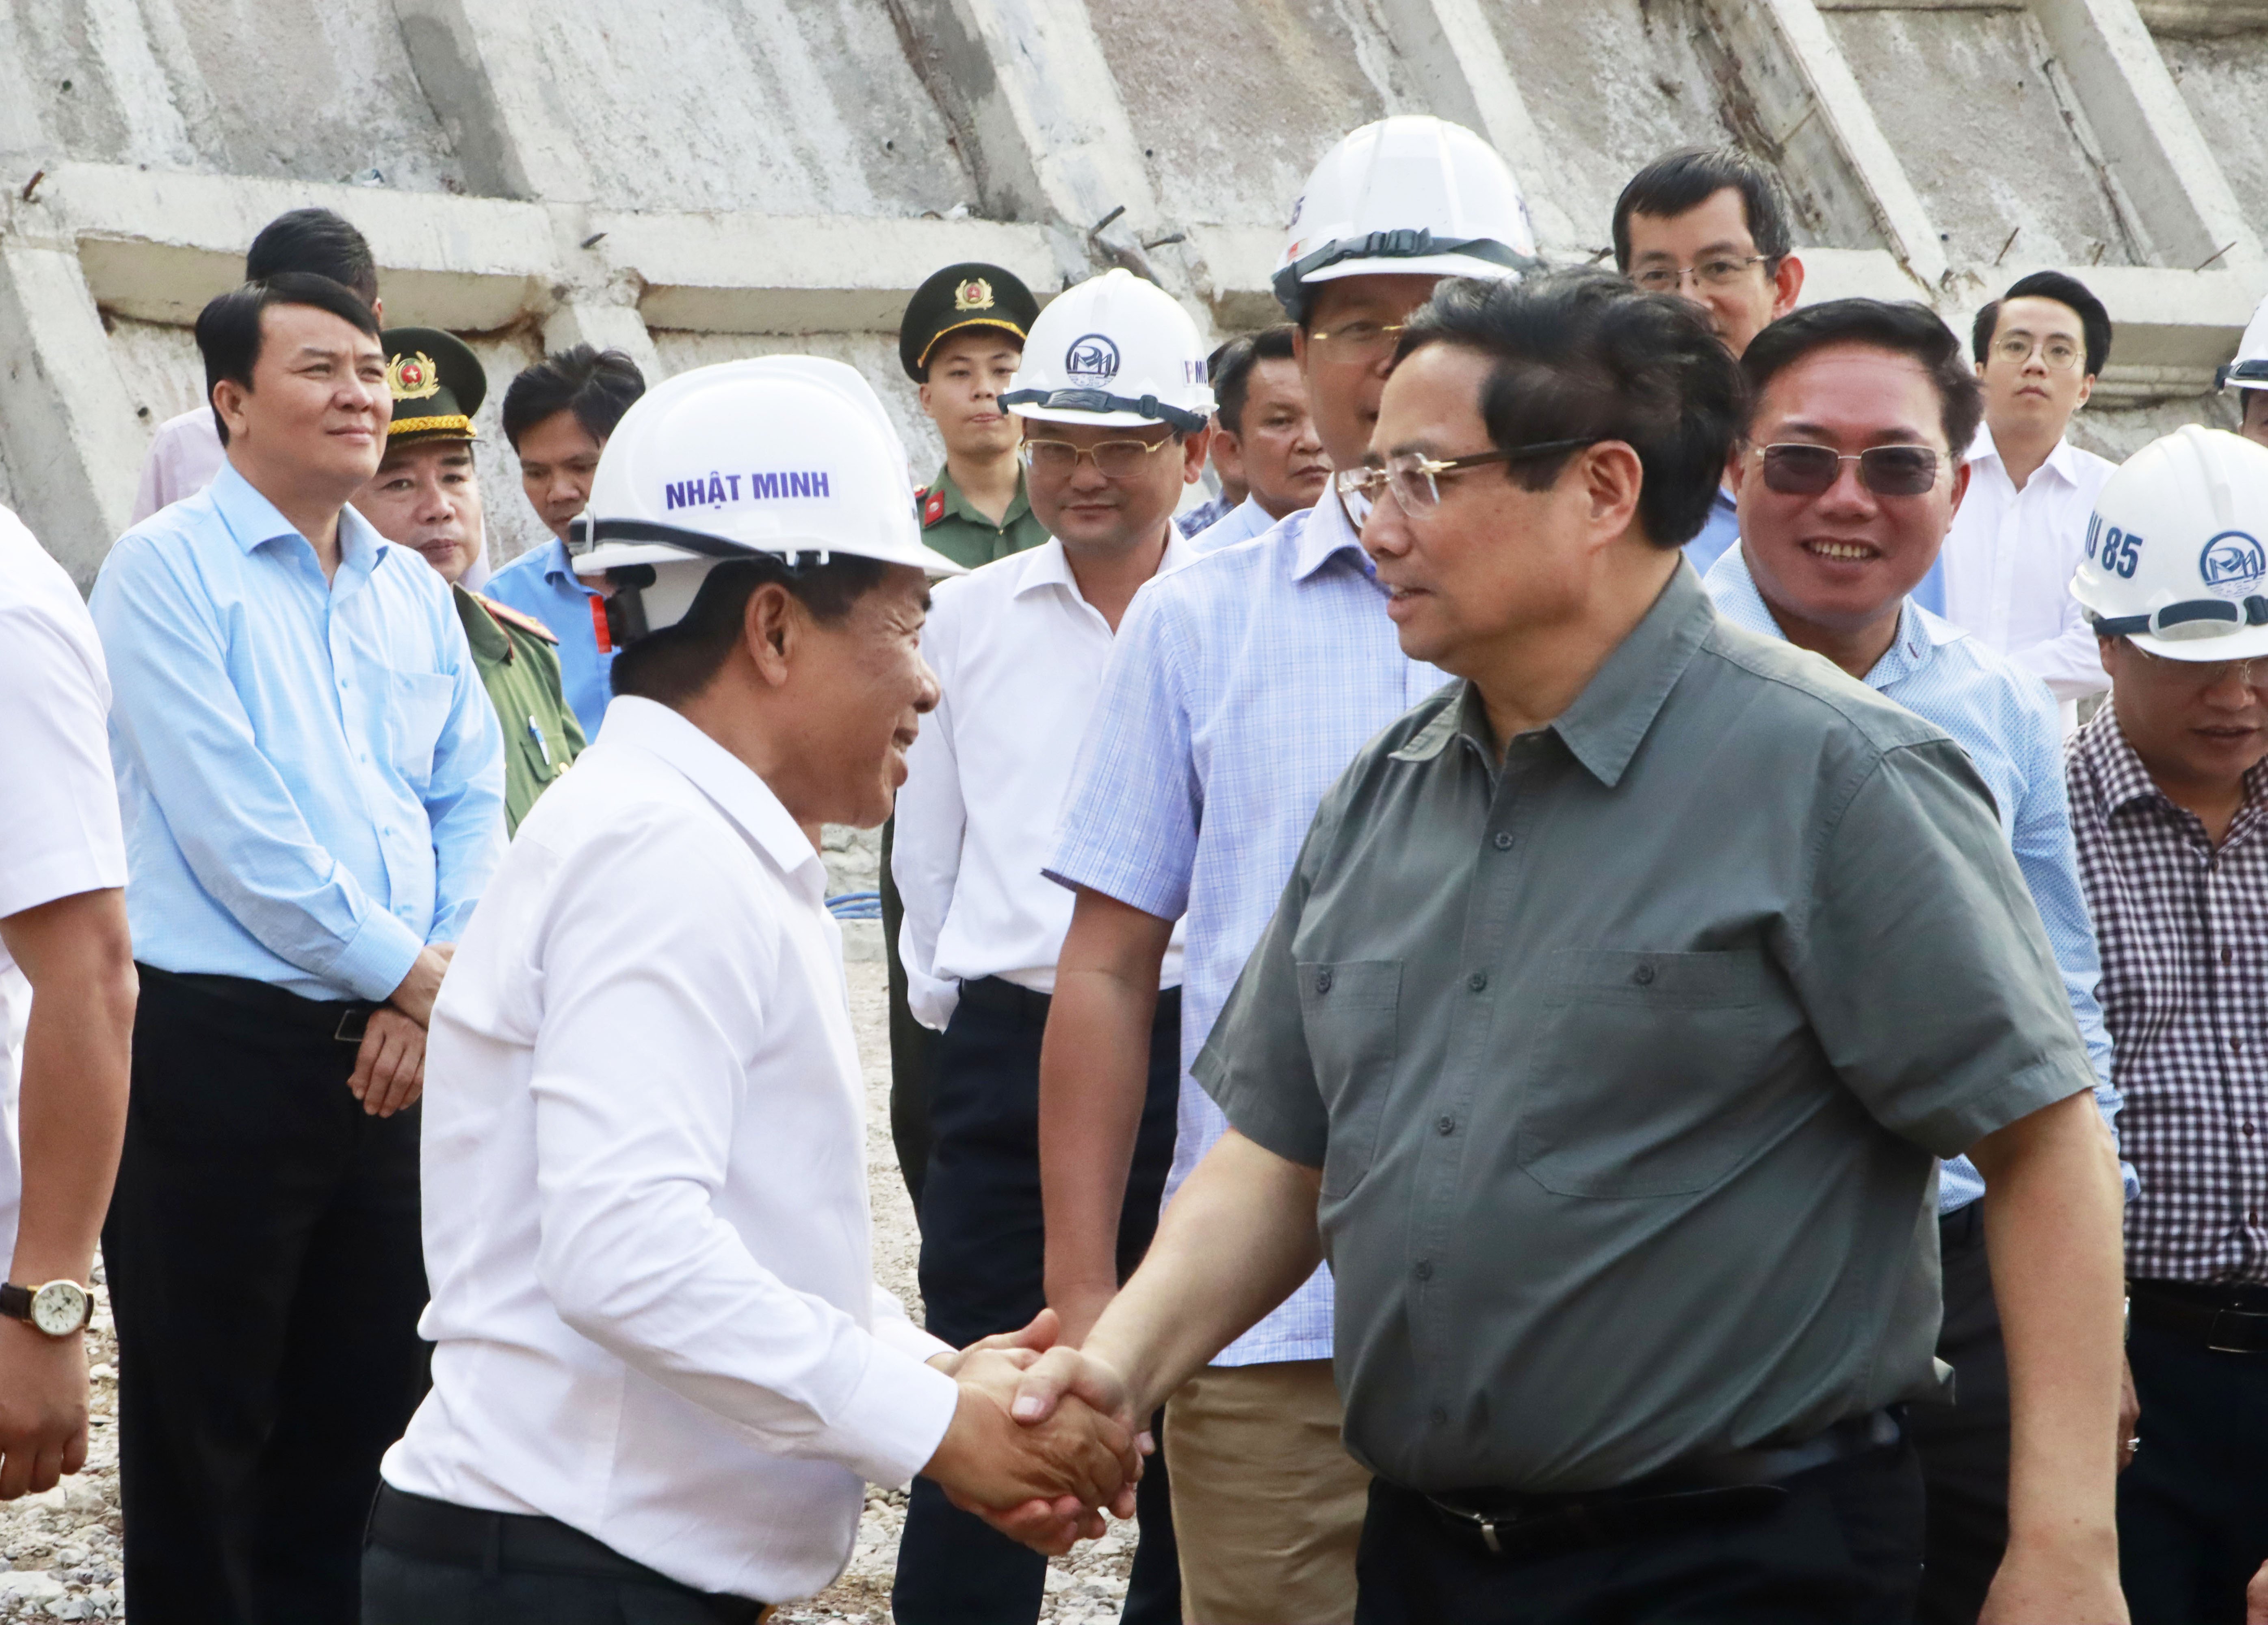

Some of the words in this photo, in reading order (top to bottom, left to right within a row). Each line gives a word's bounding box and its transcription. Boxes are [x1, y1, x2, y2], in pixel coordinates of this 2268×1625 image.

[666, 470, 741, 509] NHẬT
[752, 472, 830, 499] MINH
[2102, 526, 2143, 578] 85
